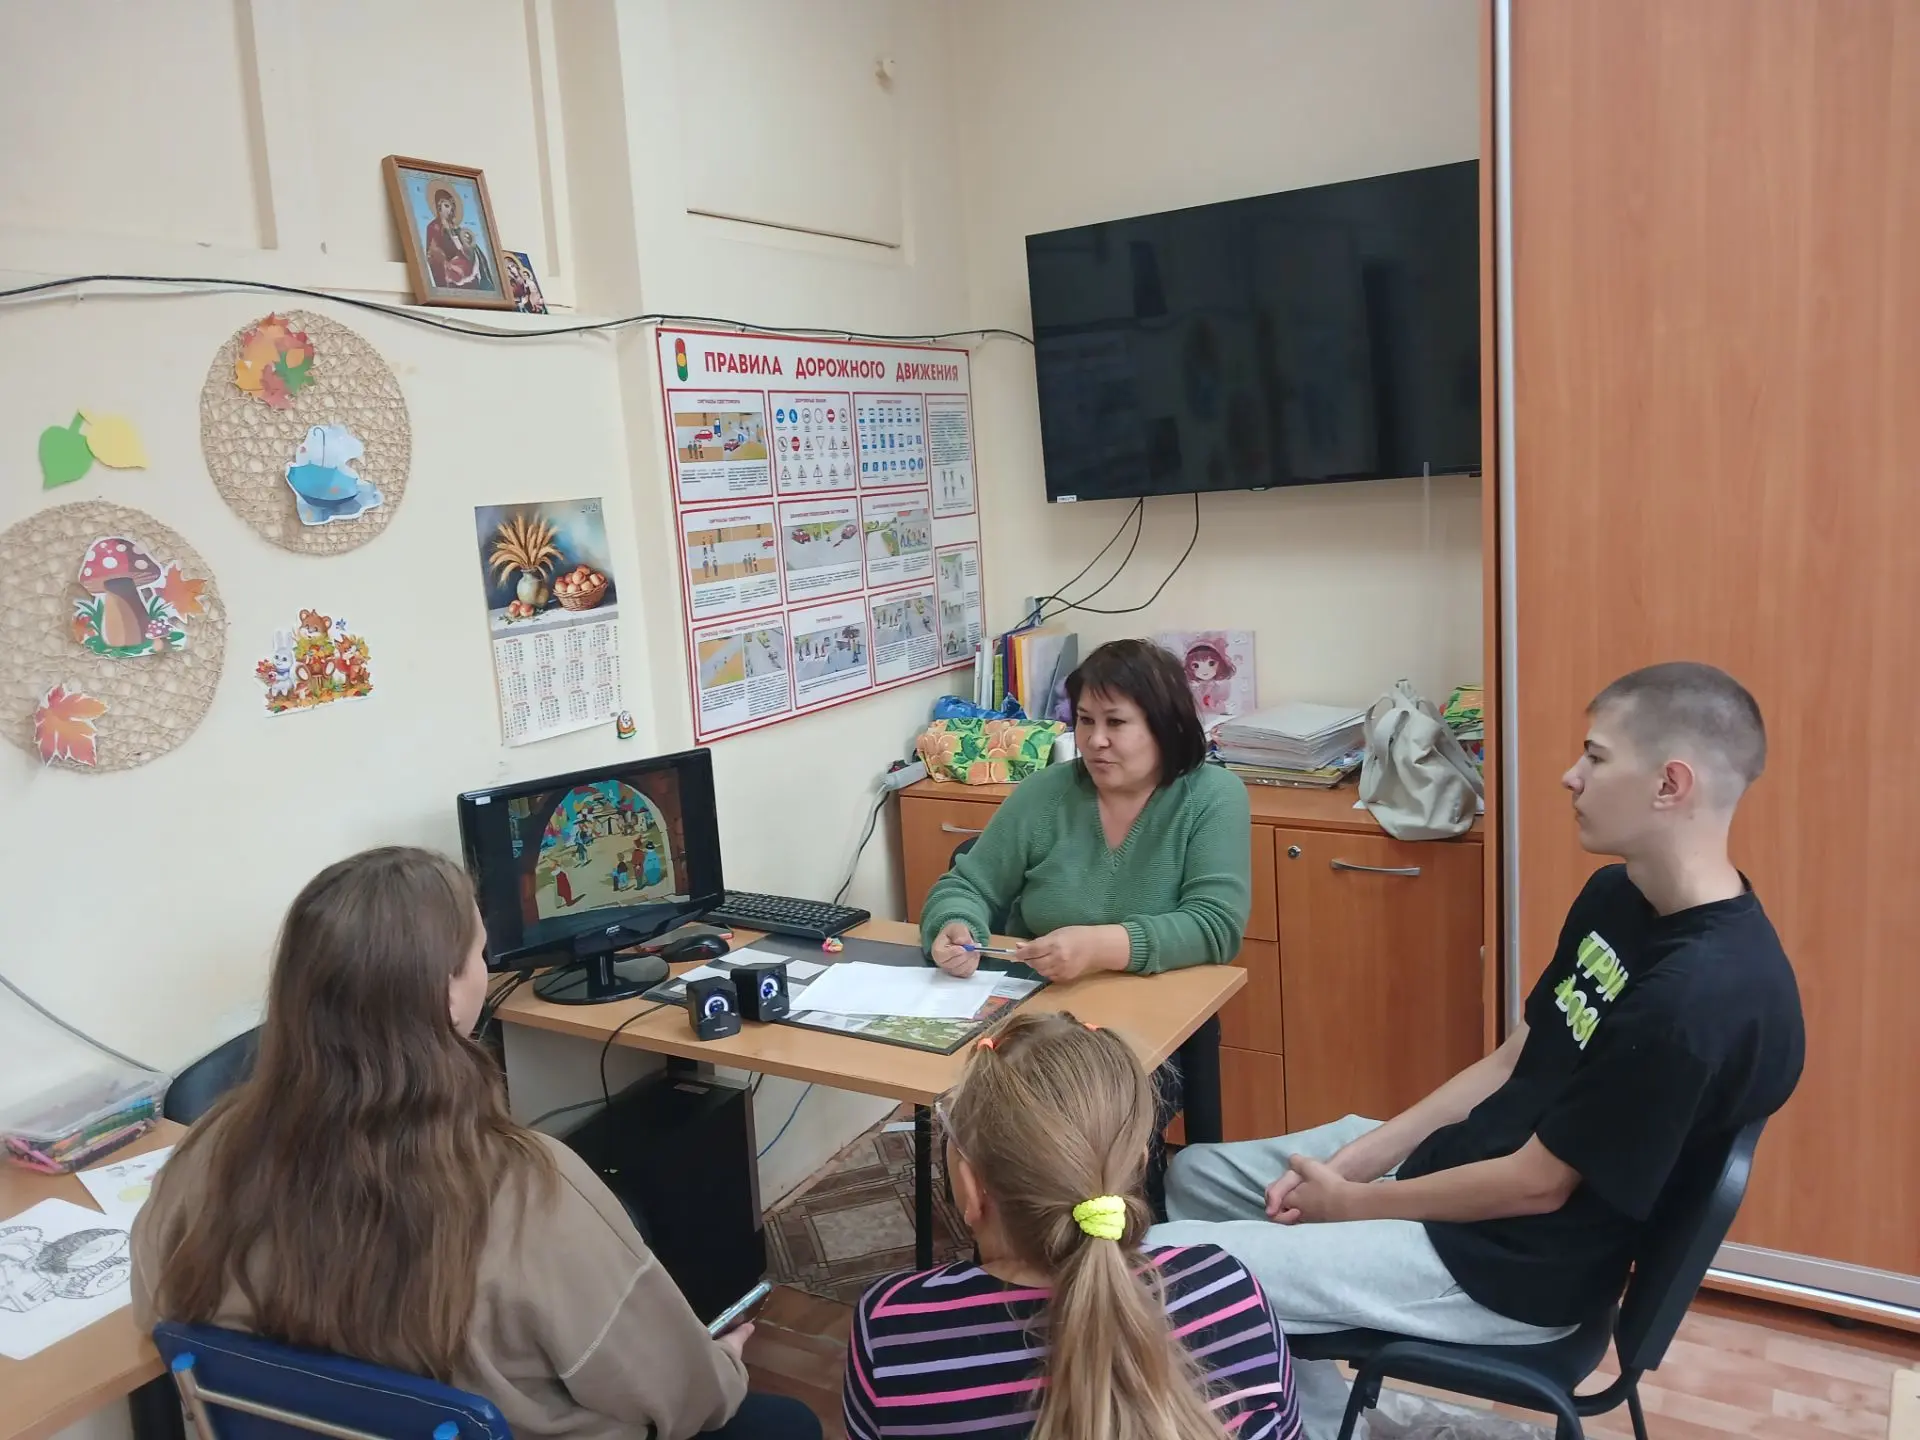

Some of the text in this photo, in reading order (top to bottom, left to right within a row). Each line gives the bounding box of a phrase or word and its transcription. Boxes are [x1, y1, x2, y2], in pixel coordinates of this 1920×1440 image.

[704, 351, 959, 382] ПРАВИЛА ДОРОЖНОГО ДВИЖЕНИЯ
